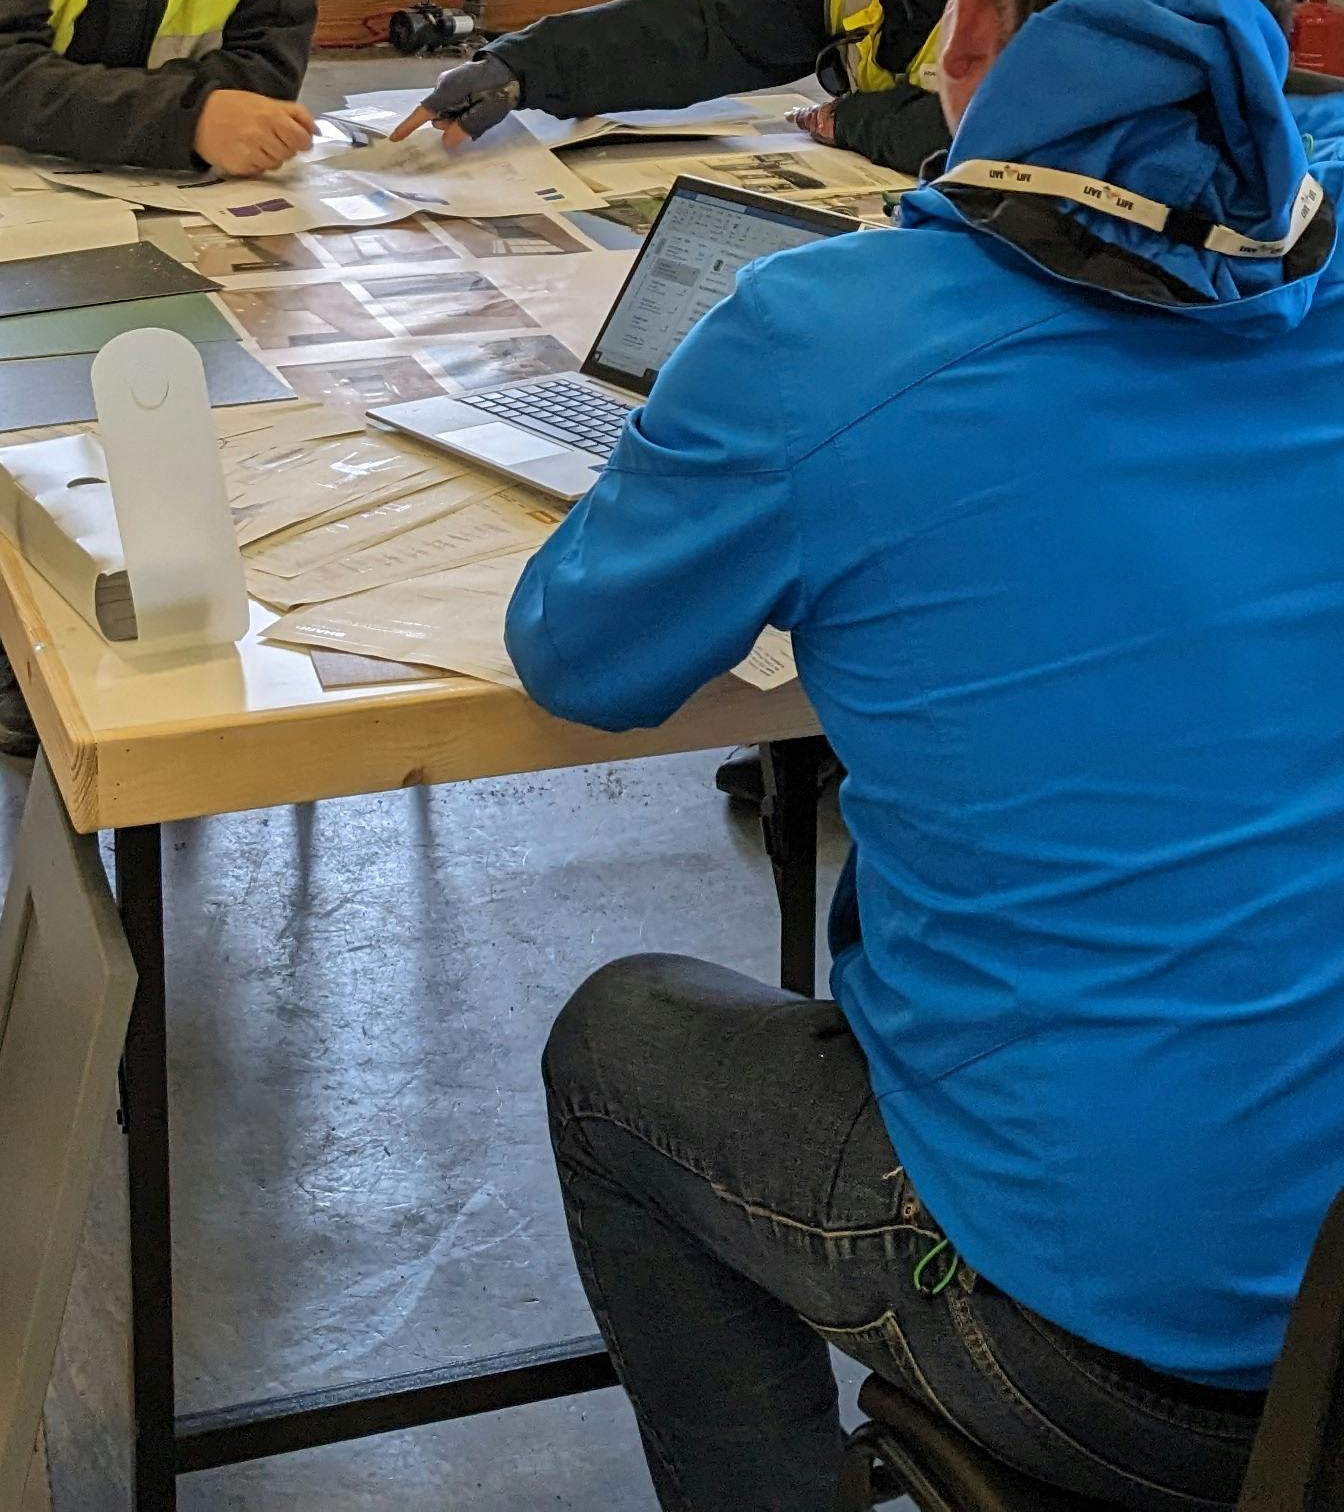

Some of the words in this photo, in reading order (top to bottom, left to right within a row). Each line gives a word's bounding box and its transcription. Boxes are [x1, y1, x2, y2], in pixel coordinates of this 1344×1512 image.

[989, 170, 1004, 179] LIVE
[1016, 172, 1031, 182] LIFE
[1083, 186, 1102, 199] LIVE
[1116, 198, 1135, 210] LIFE
